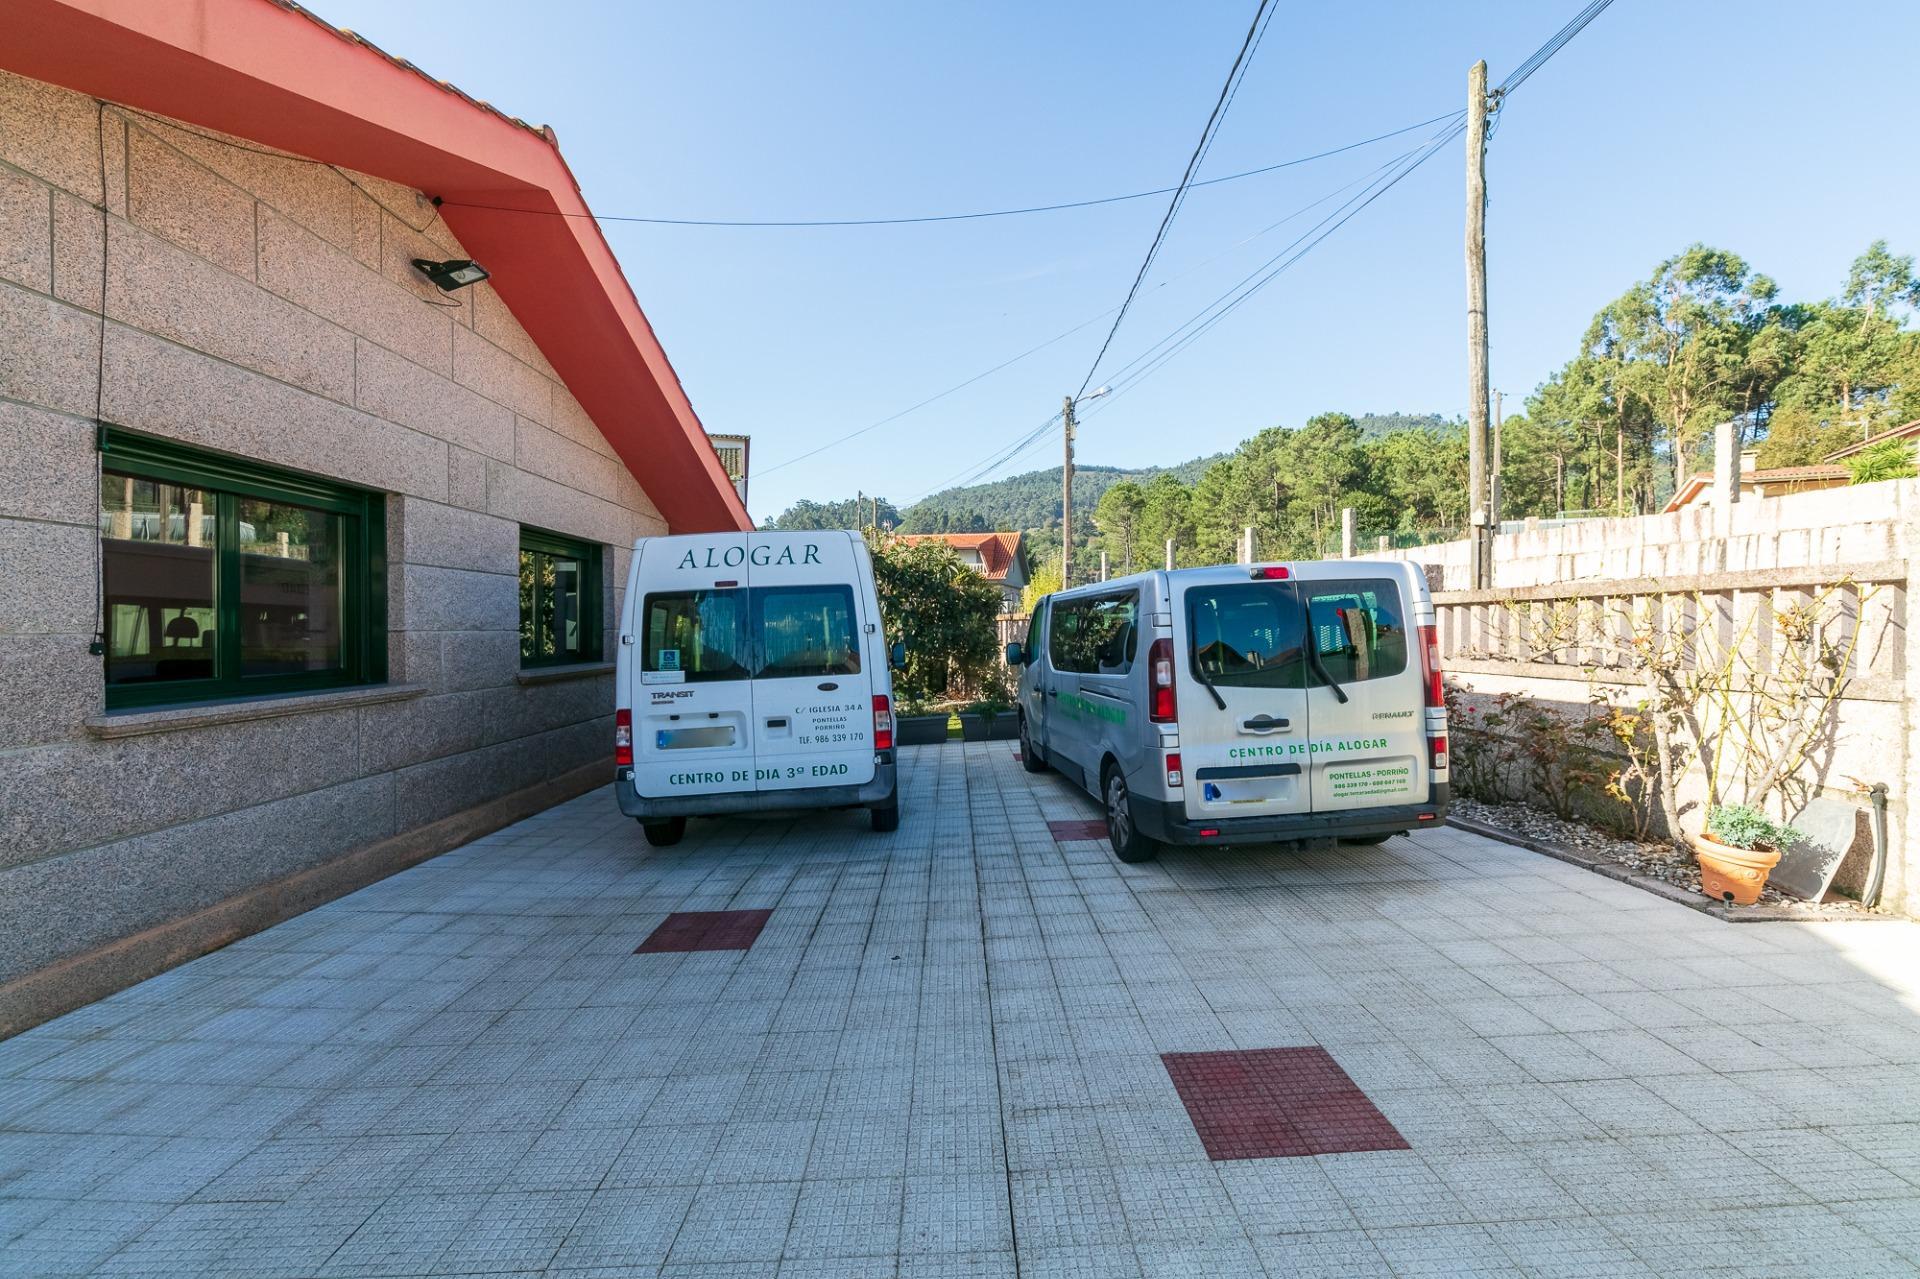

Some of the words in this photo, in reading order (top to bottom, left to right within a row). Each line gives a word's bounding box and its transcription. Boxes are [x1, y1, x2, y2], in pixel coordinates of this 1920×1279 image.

[677, 544, 822, 570] ALOGAR
[651, 691, 695, 700] TRANSIT
[809, 705, 841, 713] IGLESIA
[1372, 710, 1415, 720] RENAULT
[799, 736, 812, 745] TLF.
[815, 735, 829, 743] 986
[832, 733, 846, 742] 339
[850, 732, 864, 741] 170
[1229, 745, 1284, 758] CENTRO
[1289, 744, 1305, 754] DE
[1311, 740, 1333, 753] DÍA
[1338, 738, 1388, 751] ALOGAR
[670, 771, 724, 785] CENTRO
[732, 770, 749, 782] DE
[756, 768, 780, 780] DIA
[812, 763, 848, 776] EDAD
[1329, 770, 1371, 780] PONTELLAS
[1376, 766, 1409, 776] PORRIÑO
